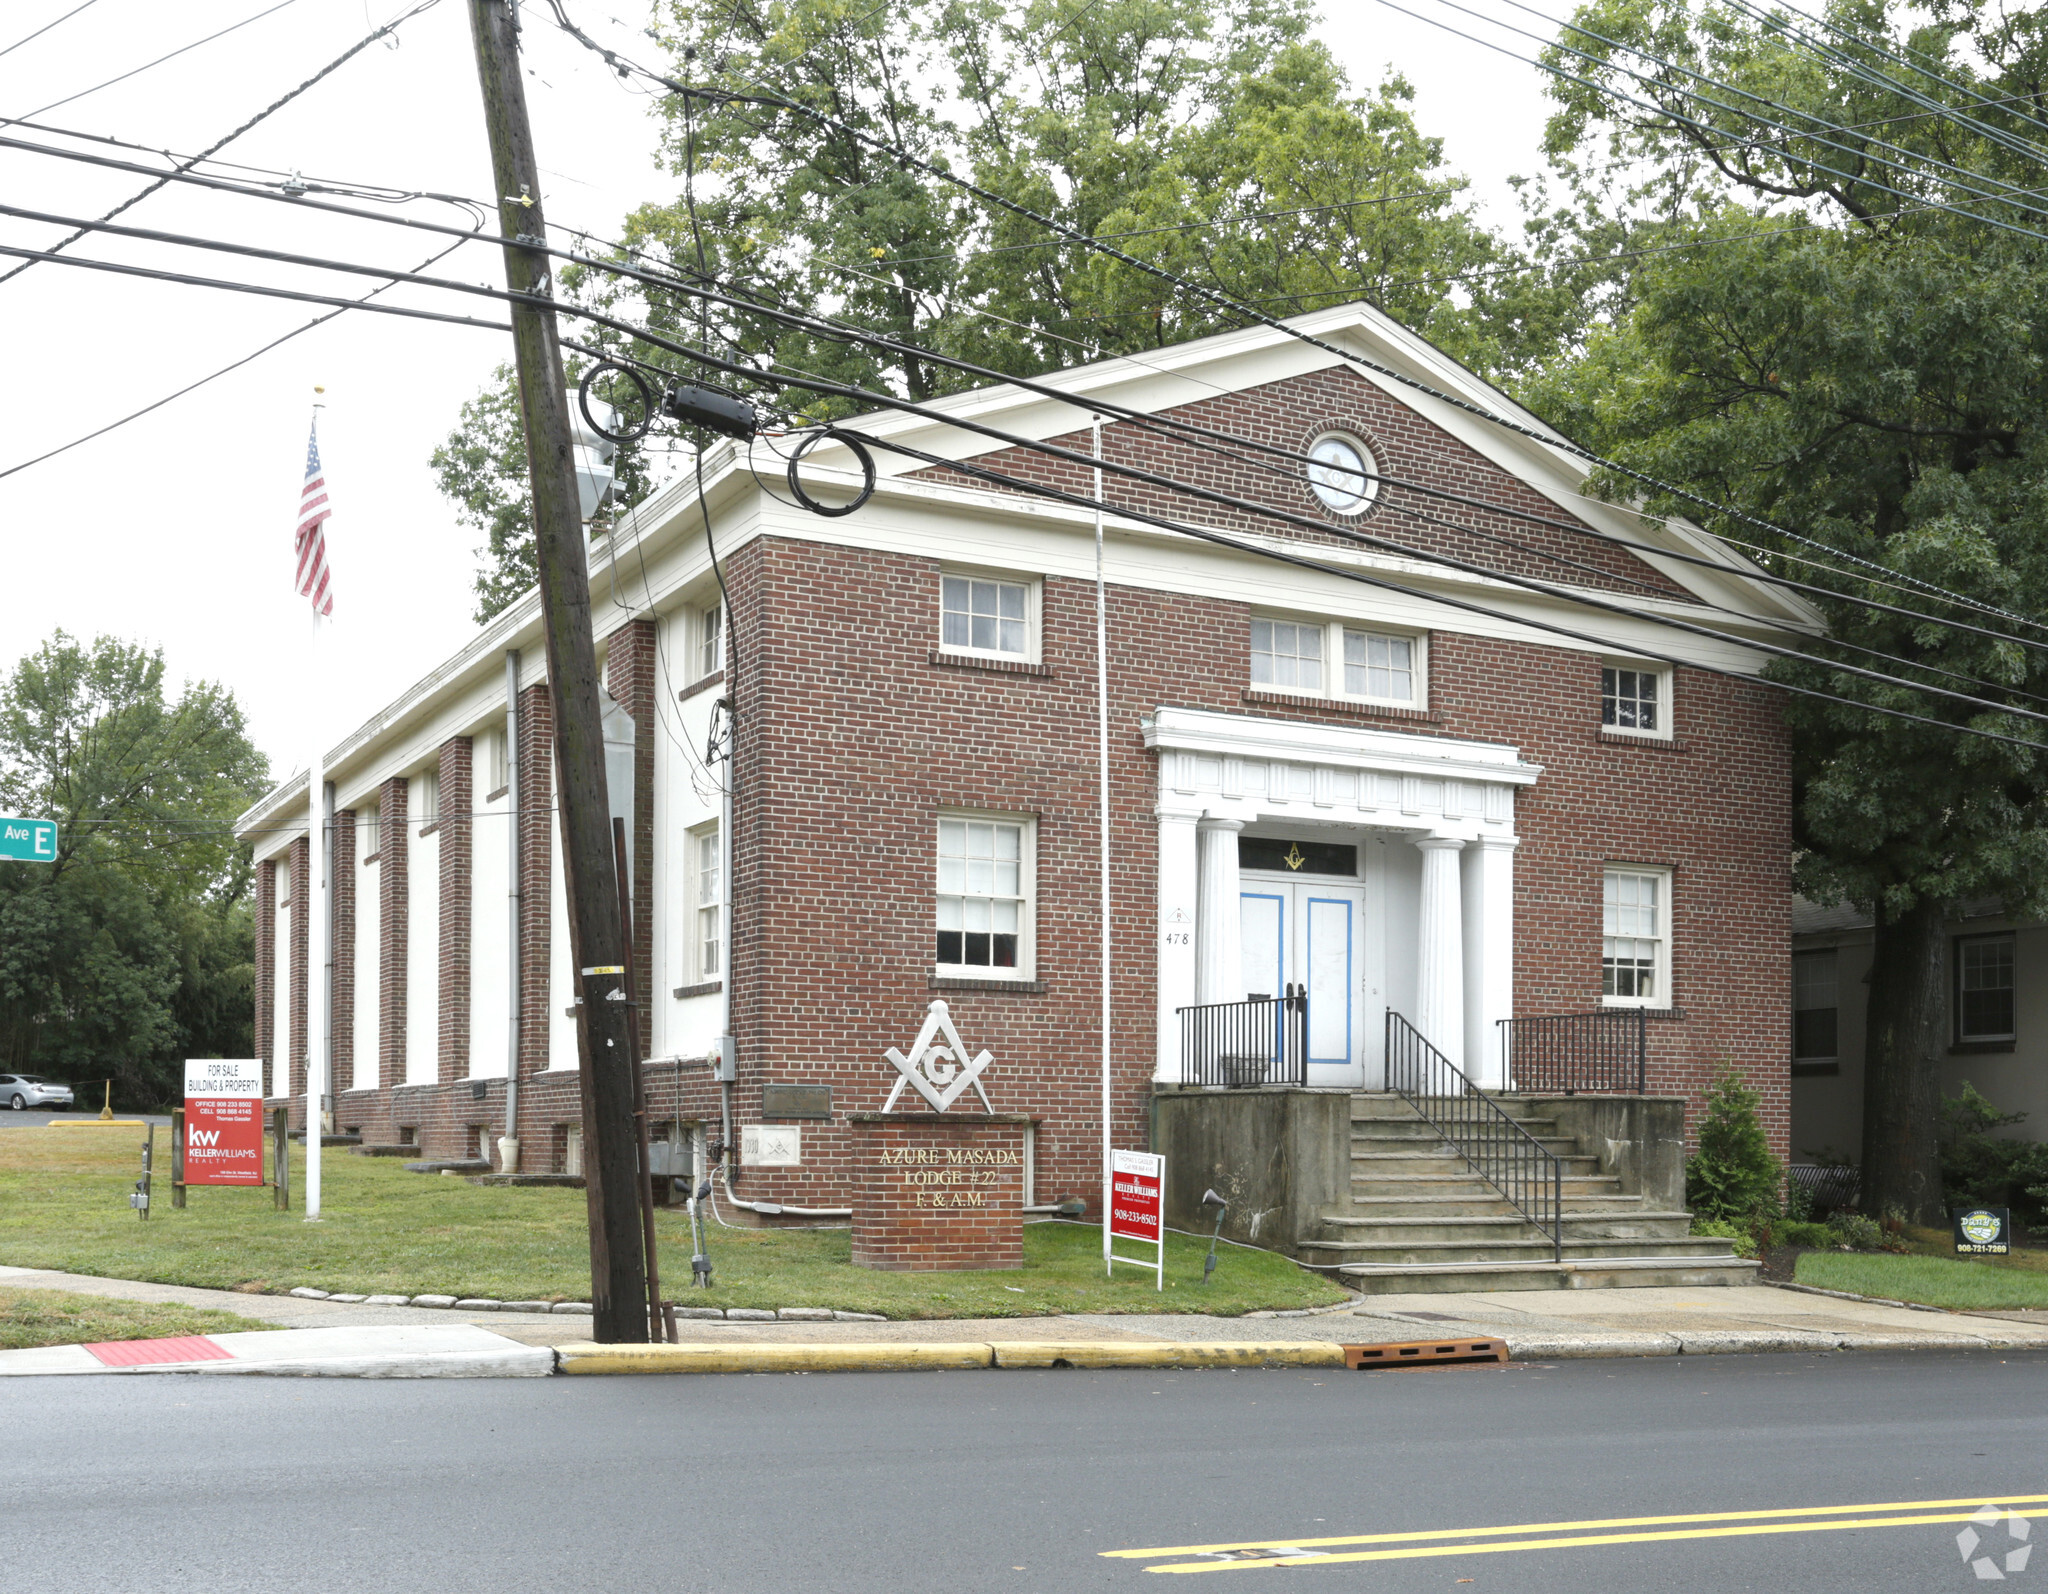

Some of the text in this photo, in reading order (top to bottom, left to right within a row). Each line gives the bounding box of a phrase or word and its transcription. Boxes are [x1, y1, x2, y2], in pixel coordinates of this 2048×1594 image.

[4, 825, 51, 854] Ave E
[1166, 933, 1189, 945] 478
[208, 1065, 239, 1076] FOR SALE
[189, 1080, 259, 1091] BUILDING & PROPERTY
[189, 1123, 220, 1146] kw
[879, 1149, 1018, 1164] AZURE MASADA
[904, 1171, 997, 1185] LODGE #22
[1115, 1182, 1158, 1197] KELLER WILLIAMS
[916, 1192, 986, 1206] F. & A.M.
[1114, 1208, 1157, 1225] 908-233-8502
[1957, 1244, 2007, 1253] 908-721-7269
